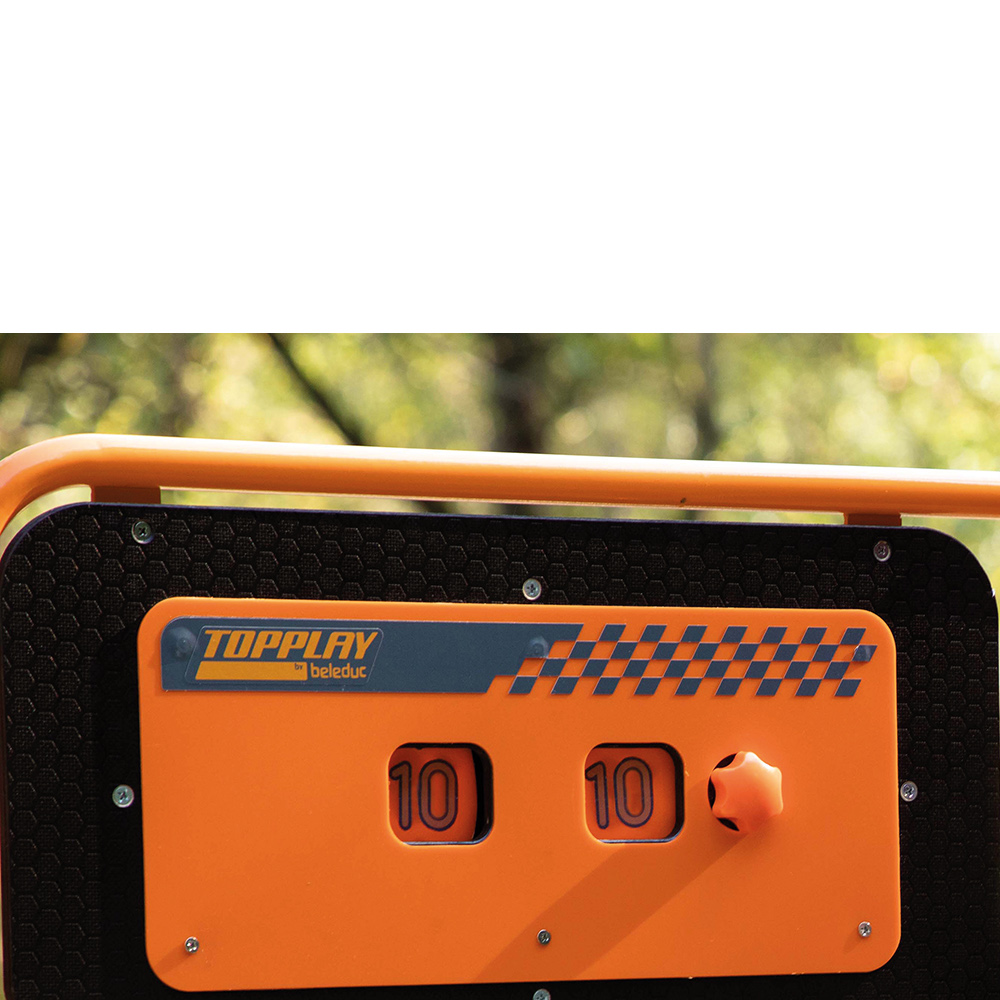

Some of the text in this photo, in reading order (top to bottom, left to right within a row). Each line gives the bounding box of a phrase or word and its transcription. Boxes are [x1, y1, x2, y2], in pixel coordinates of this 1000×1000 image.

[203, 630, 378, 659] TOPPLAY
[294, 662, 367, 679] by beleduc
[388, 758, 459, 831] 10
[585, 757, 654, 829] 10
